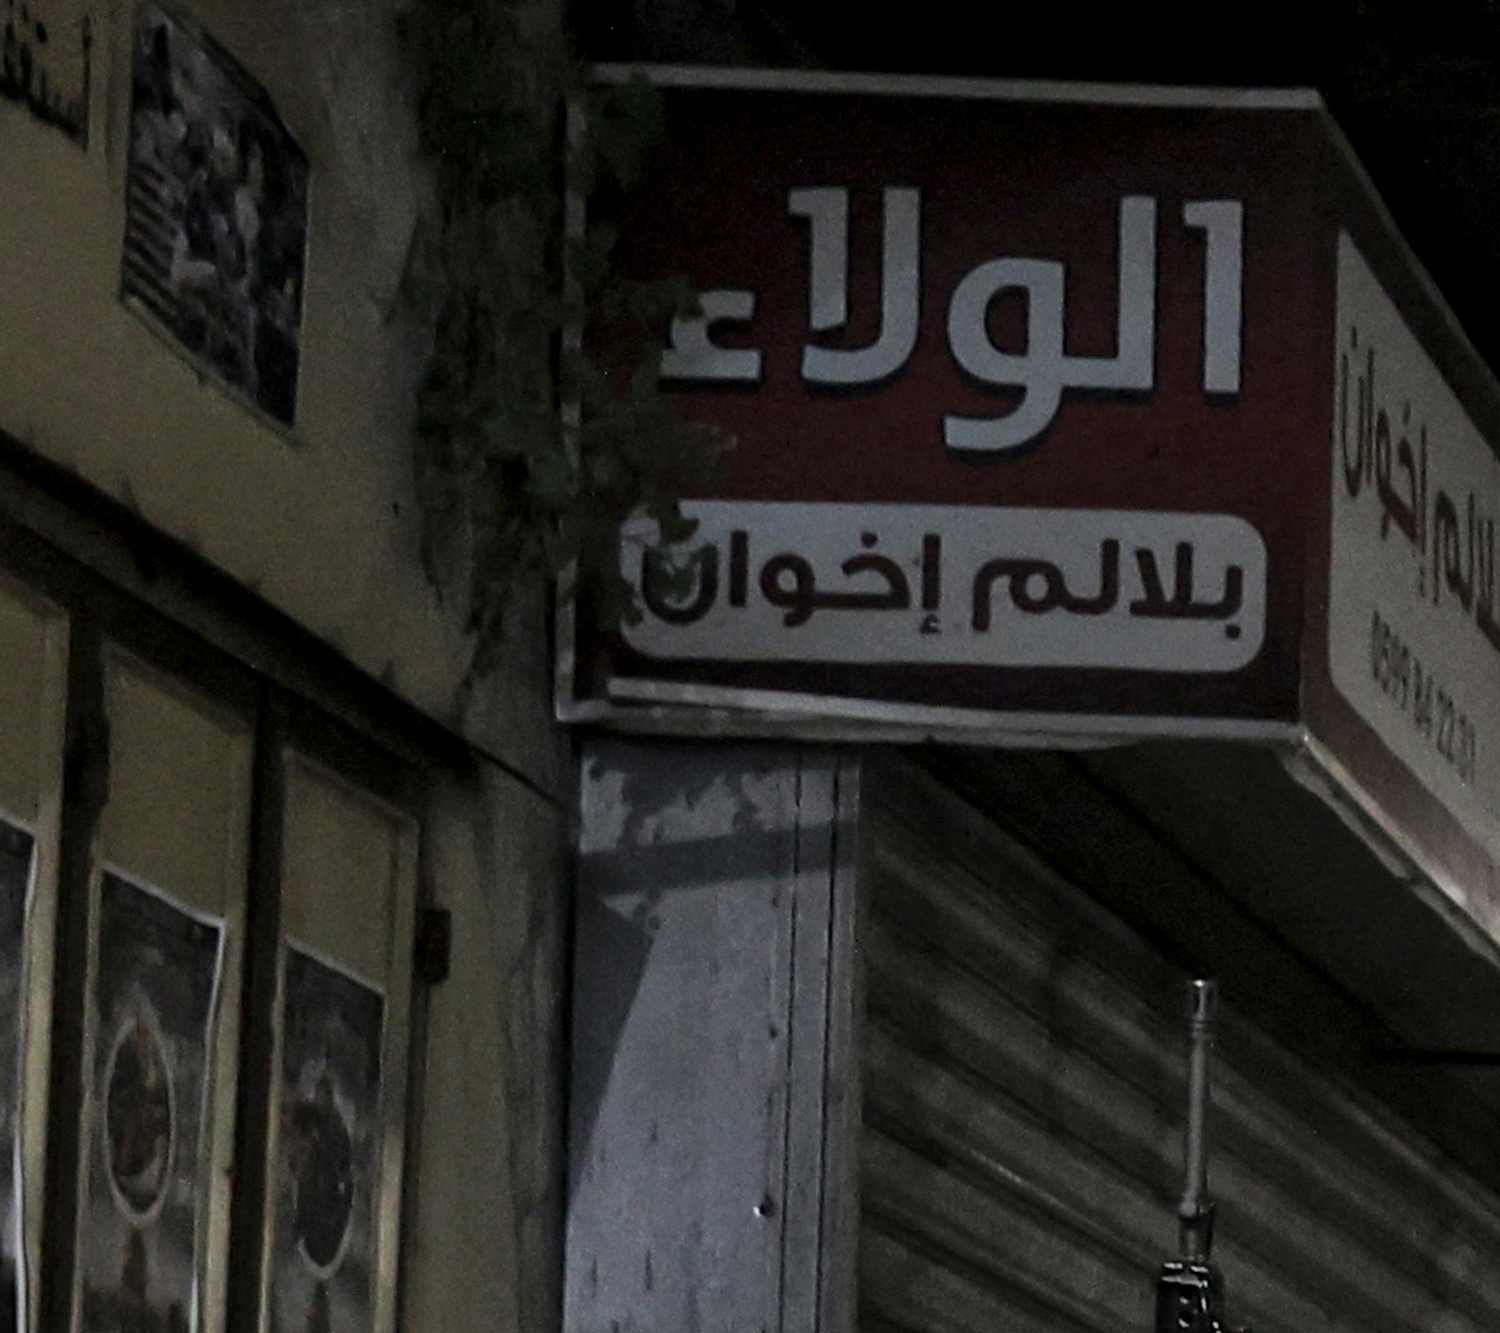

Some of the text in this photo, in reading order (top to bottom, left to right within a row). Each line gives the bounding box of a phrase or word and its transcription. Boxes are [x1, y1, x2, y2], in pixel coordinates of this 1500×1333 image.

[662, 187, 1245, 455] الولاء
[641, 531, 1247, 641] بلالم إخوان
